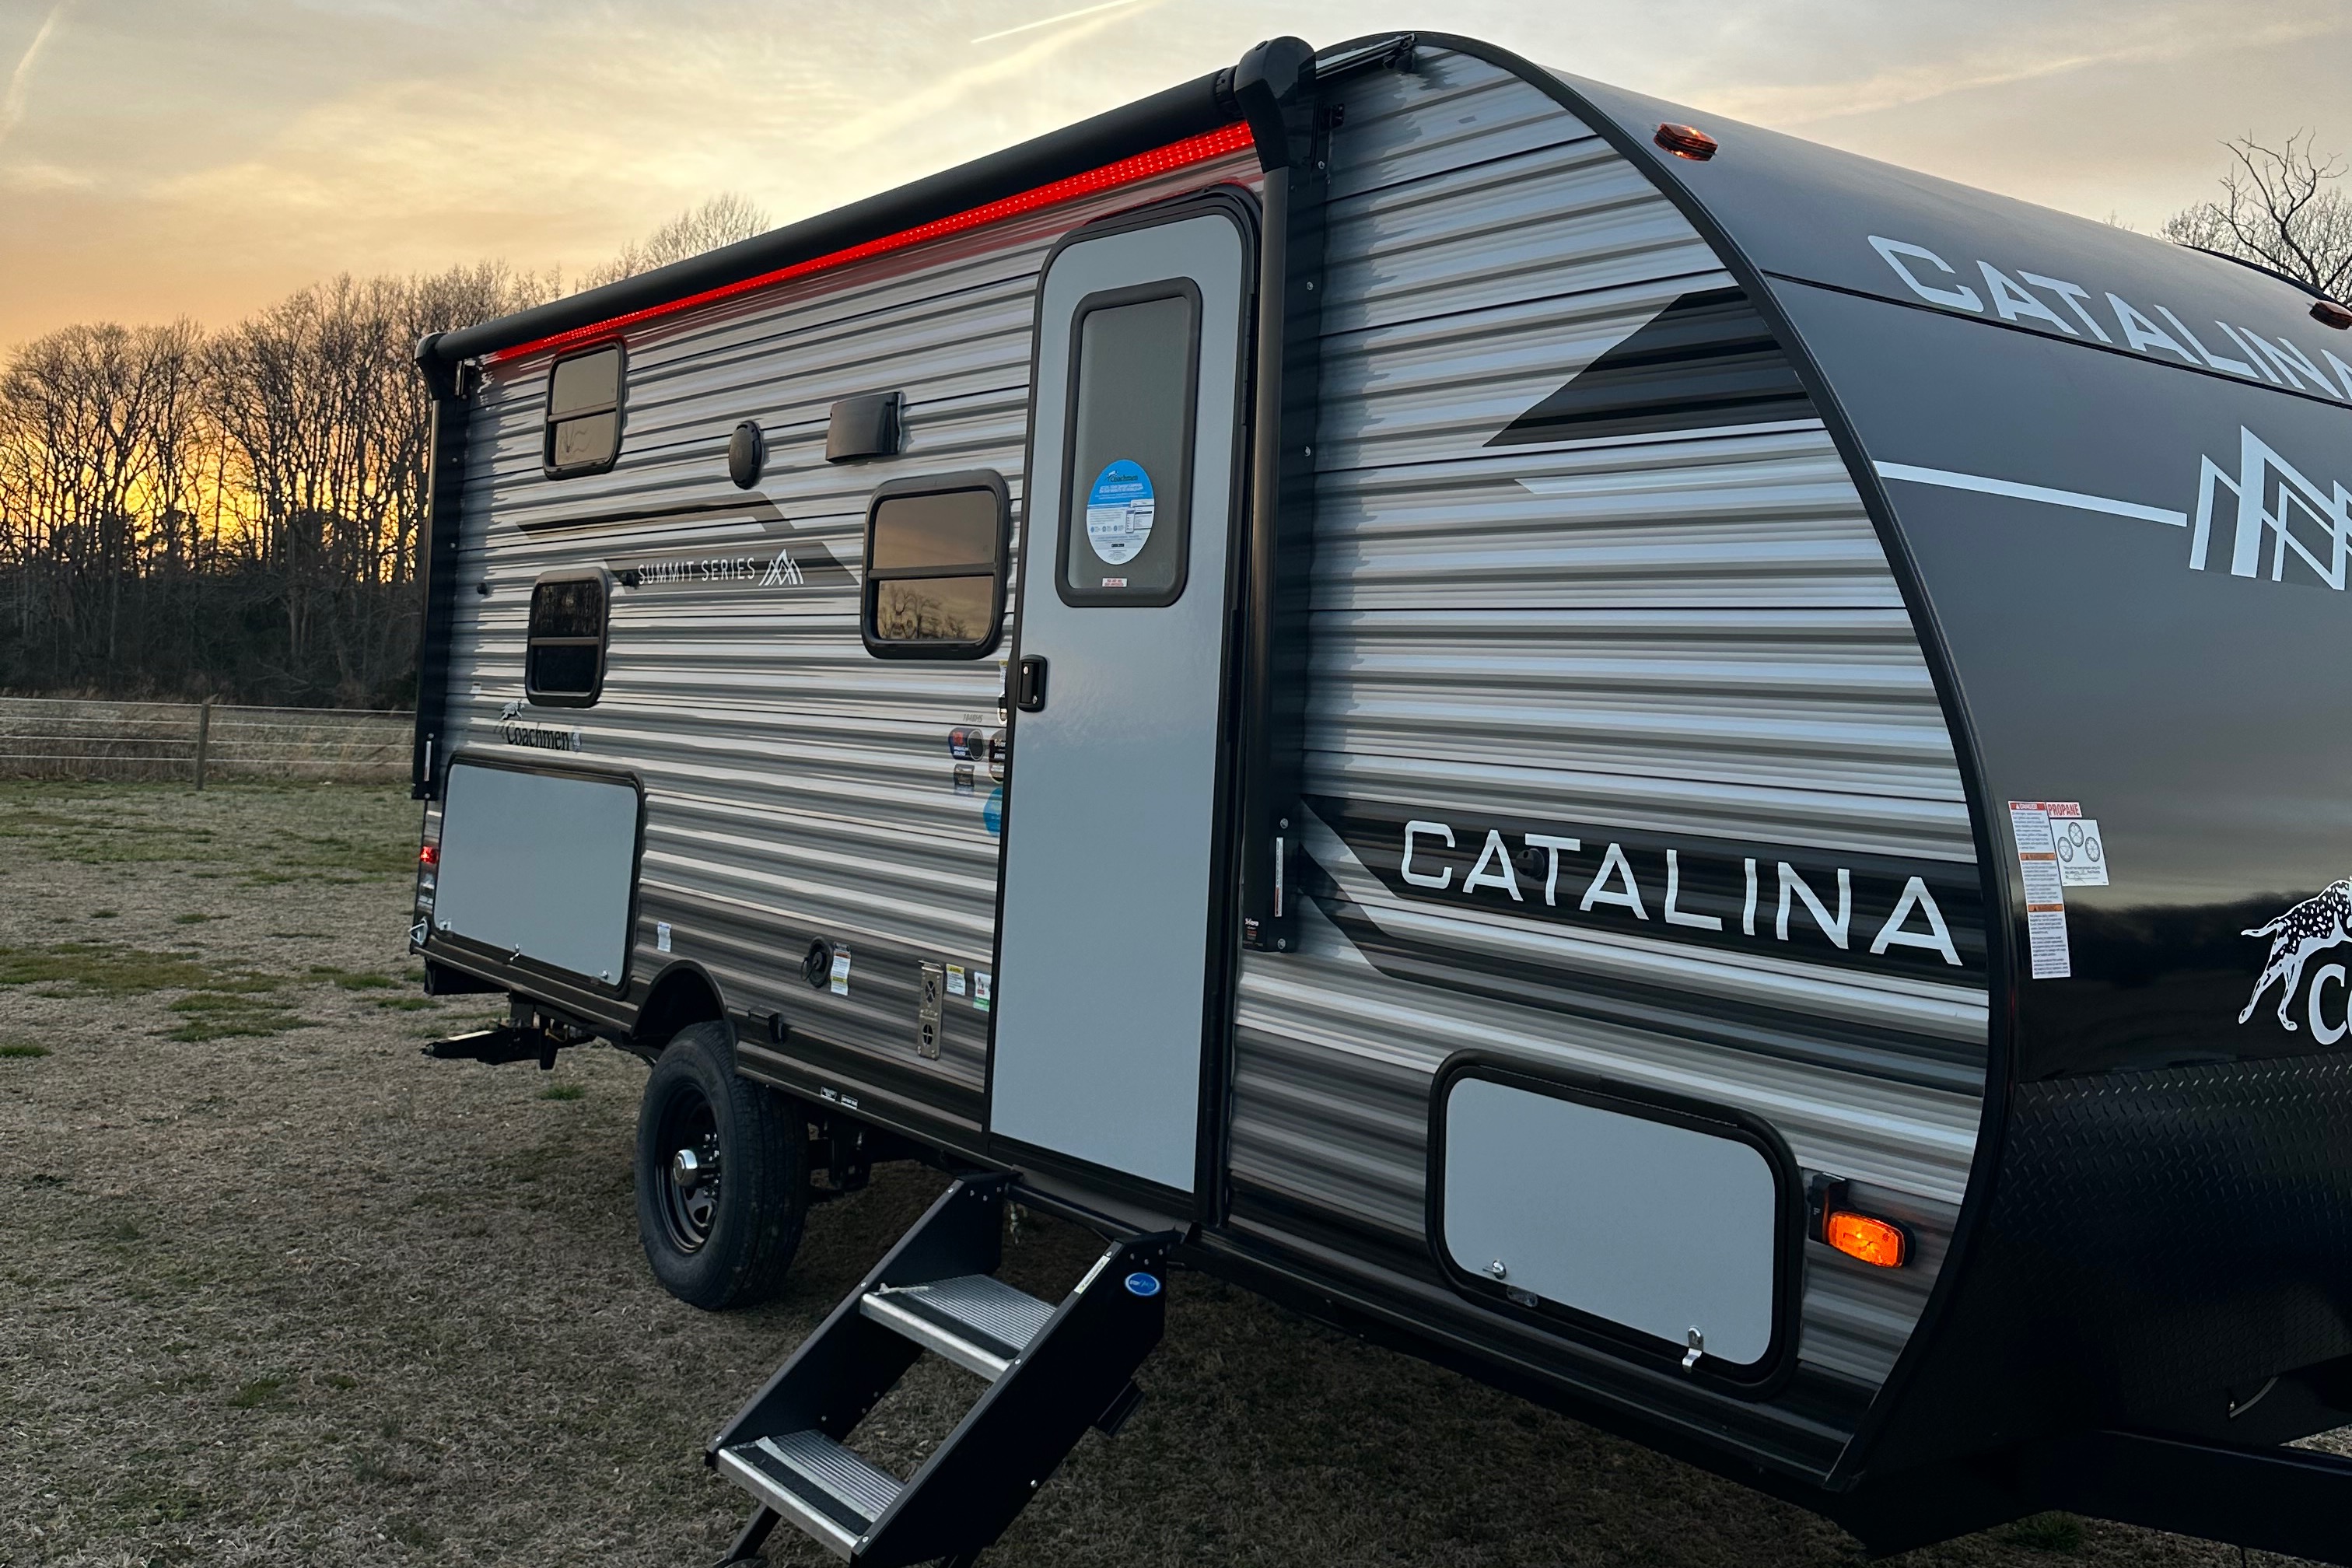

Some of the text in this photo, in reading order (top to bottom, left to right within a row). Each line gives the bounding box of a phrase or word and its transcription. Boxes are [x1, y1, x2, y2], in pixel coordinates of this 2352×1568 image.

[638, 557, 755, 585] SUMMIT SERIES
[506, 722, 570, 751] Coachmen
[2047, 803, 2081, 817] PROPANE
[1401, 820, 1964, 967] CATALINA
